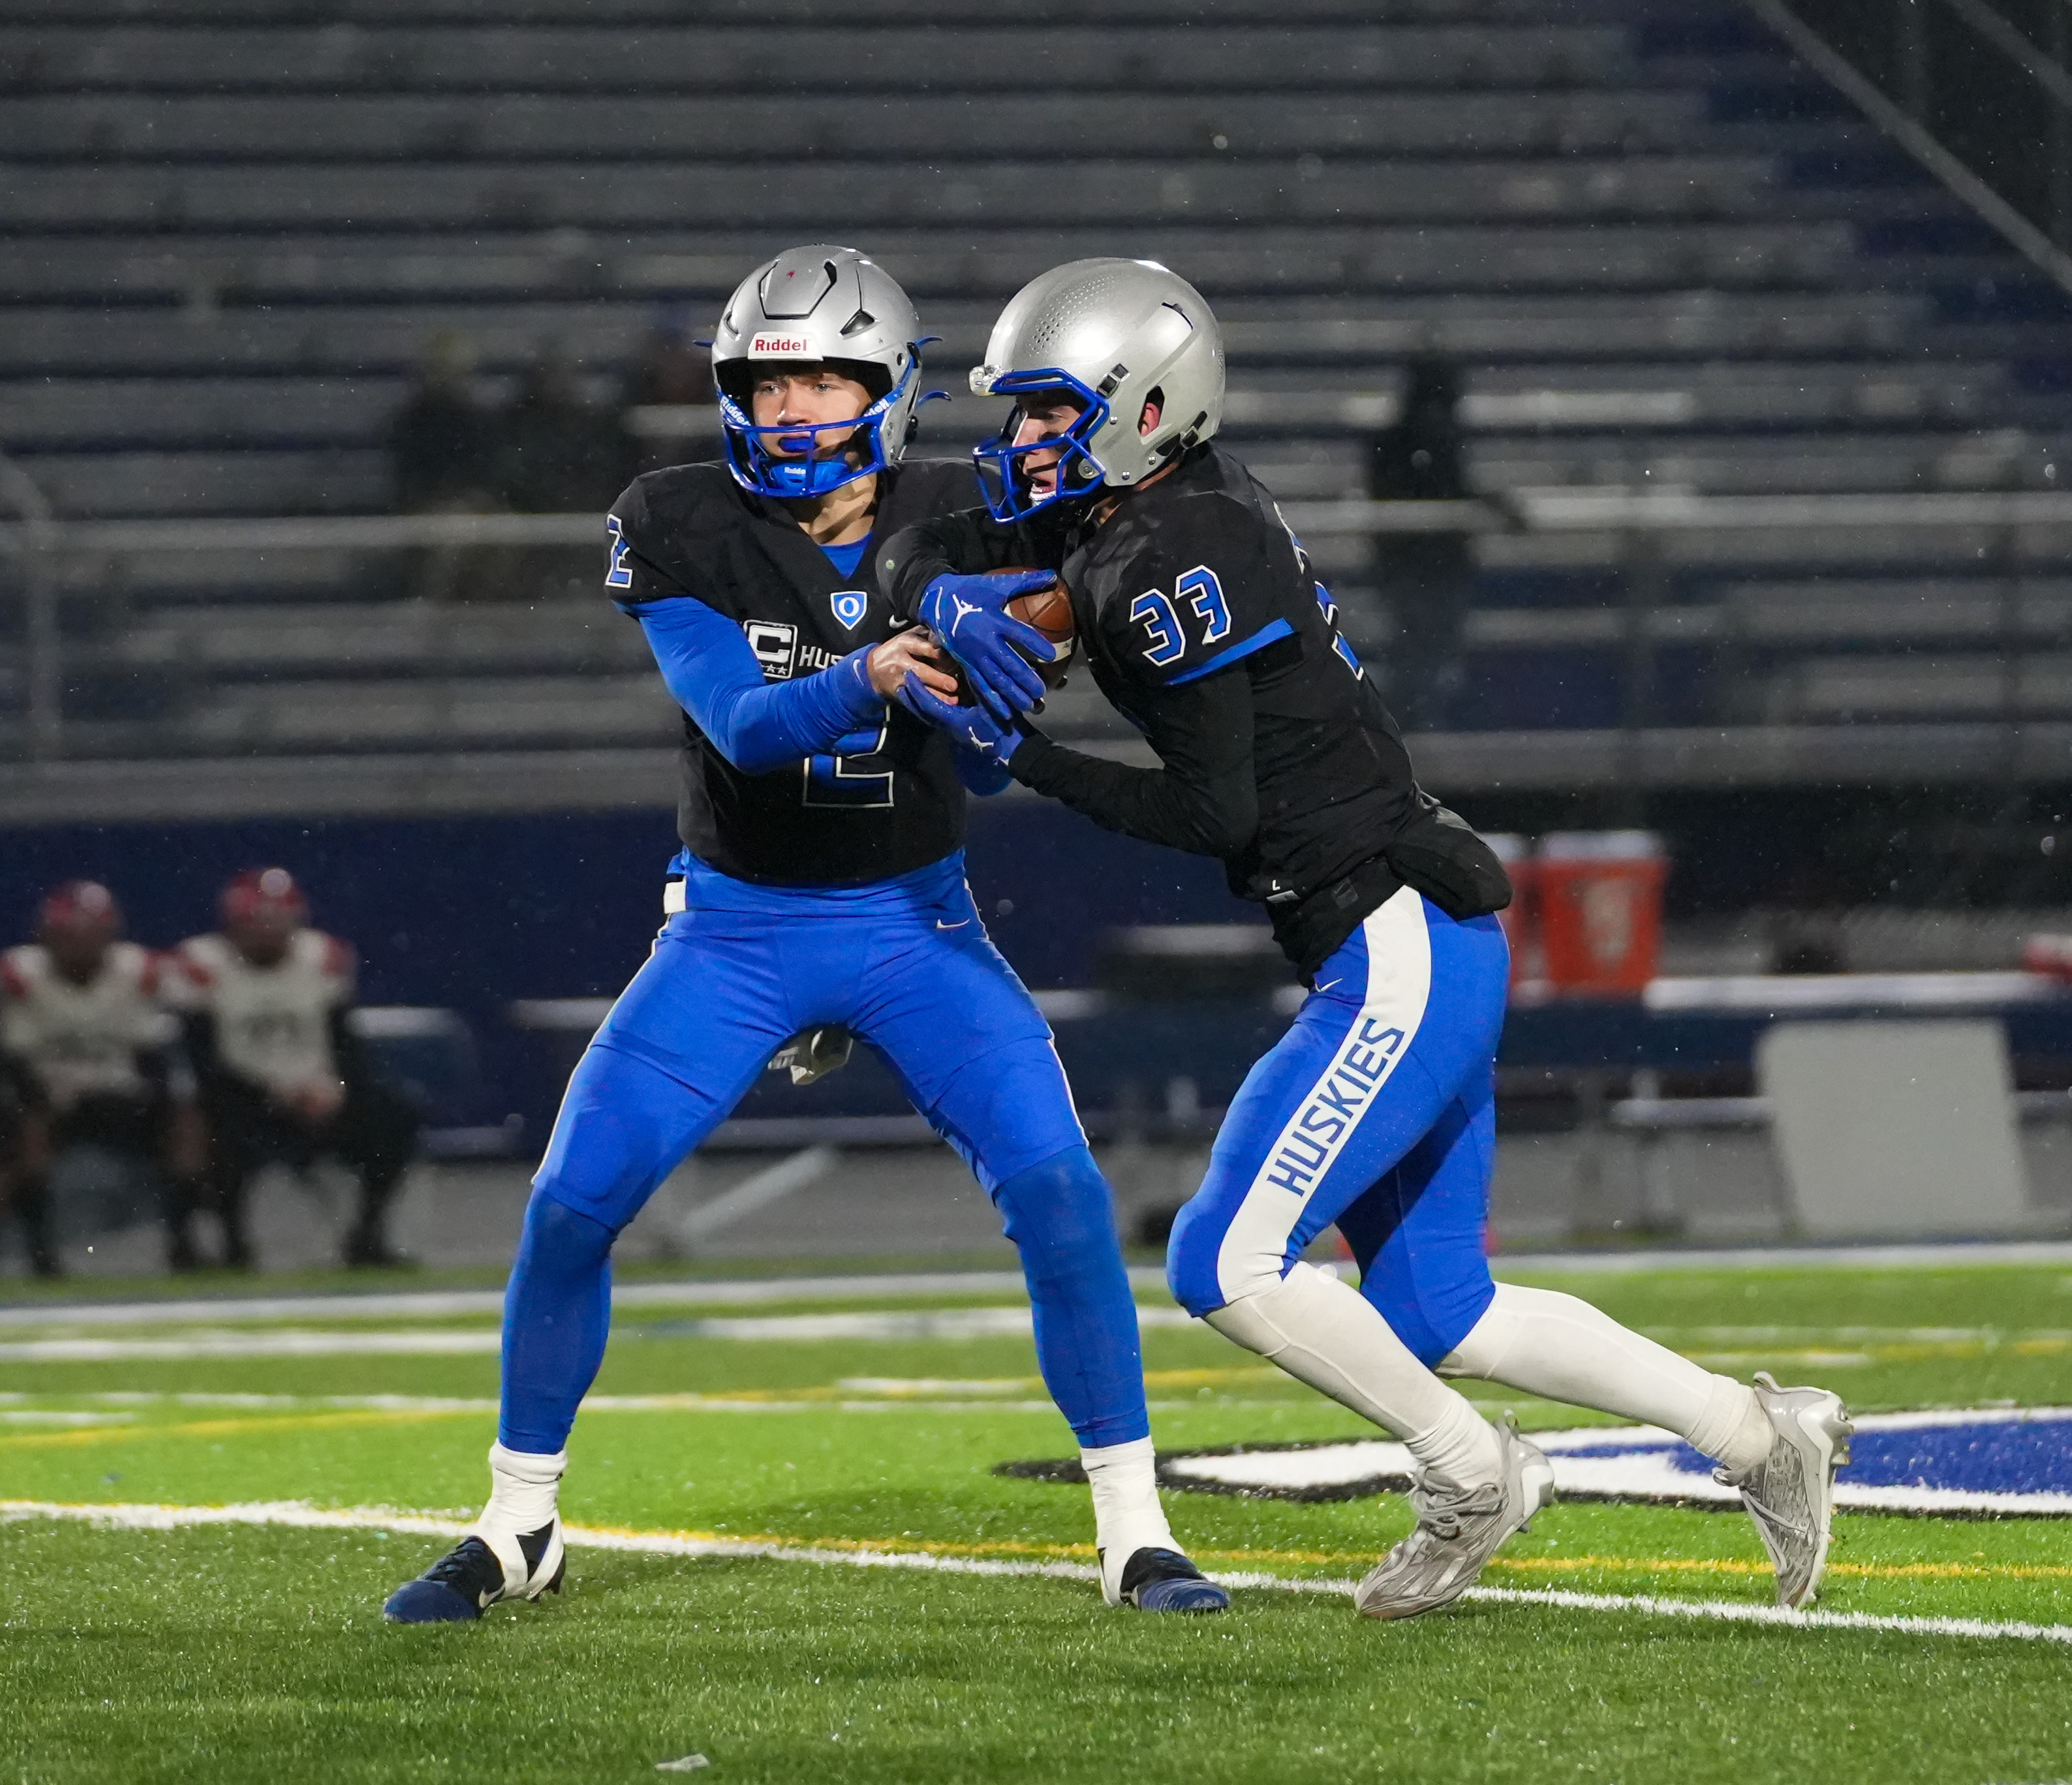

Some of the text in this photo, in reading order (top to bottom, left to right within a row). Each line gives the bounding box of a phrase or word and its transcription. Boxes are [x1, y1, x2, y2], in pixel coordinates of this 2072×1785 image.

[605, 514, 633, 589] 2
[749, 625, 792, 663] C
[1130, 565, 1232, 667] 33
[802, 705, 895, 807] 2
[1267, 1018, 1405, 1198] HUSKIES
